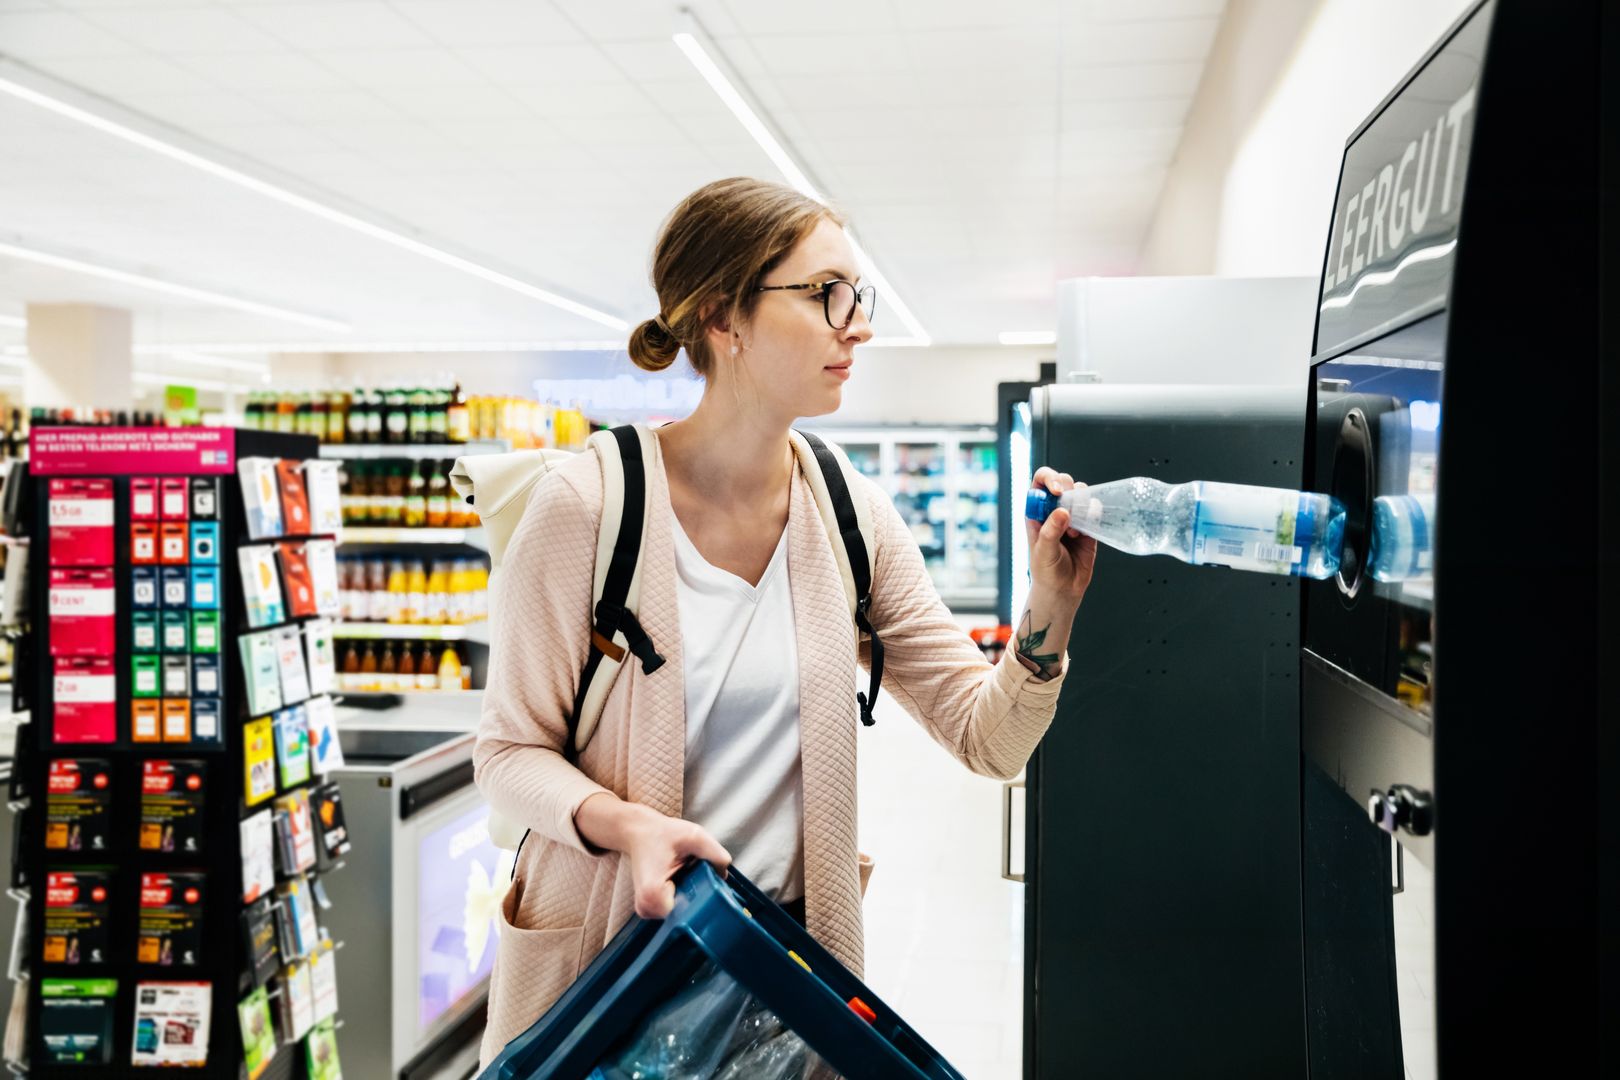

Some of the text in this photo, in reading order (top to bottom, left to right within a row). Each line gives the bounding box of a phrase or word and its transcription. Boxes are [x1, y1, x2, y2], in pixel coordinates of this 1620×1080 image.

[1323, 86, 1475, 292] LEERGUT
[36, 432, 220, 442] HIER PREPAID-ANGEBOTE UND GUTHABEN
[36, 443, 47, 452] IM
[49, 443, 84, 452] BESTEN
[85, 443, 127, 452] TELEKOM
[129, 443, 151, 452] NETZ
[60, 595, 84, 605] CENT
